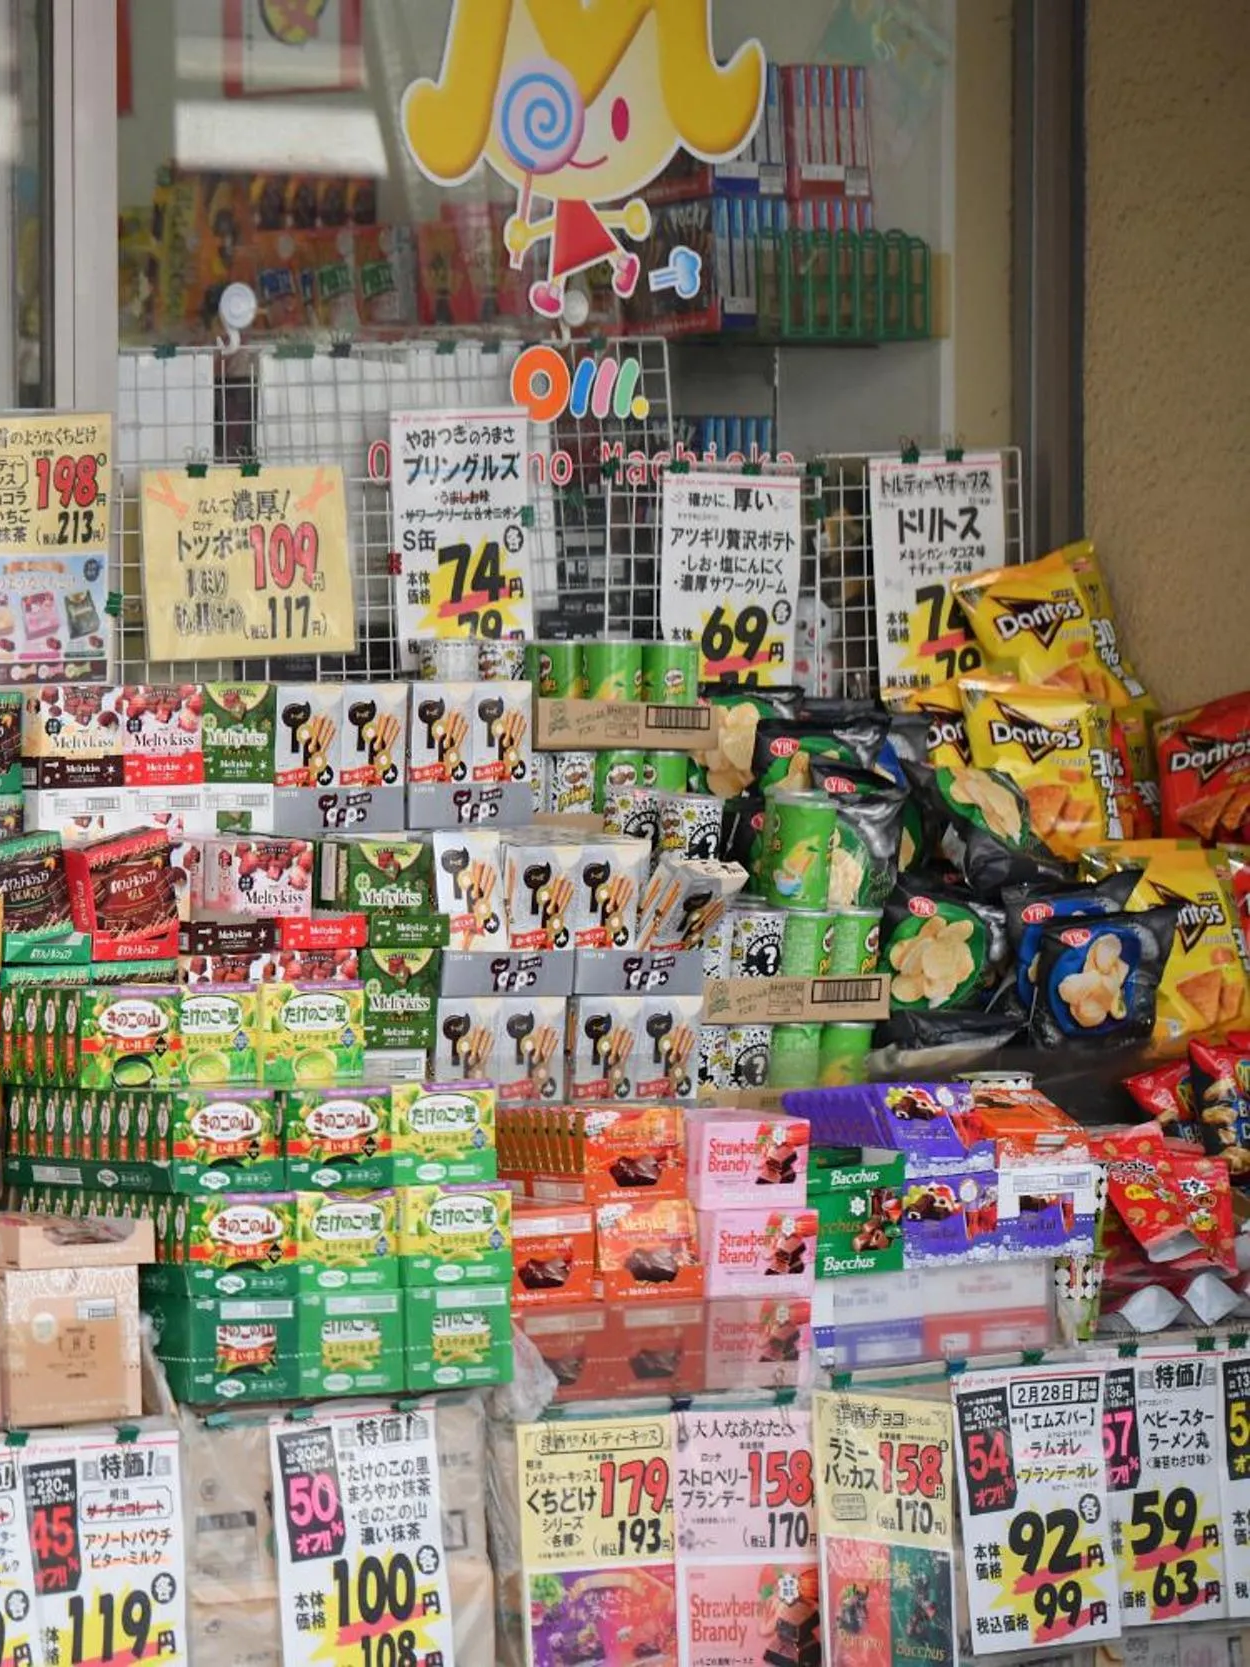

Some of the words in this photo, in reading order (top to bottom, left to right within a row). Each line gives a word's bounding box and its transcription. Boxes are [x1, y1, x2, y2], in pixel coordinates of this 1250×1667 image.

[405, 425, 516, 450] やみつきのうまさ
[402, 452, 521, 486] プリングルズ
[880, 470, 992, 498] トルティーヤチップス
[897, 505, 982, 545] ドリトス
[177, 529, 234, 562] トッポ
[402, 528, 438, 553] S缶
[670, 526, 796, 553] アツギリ贅沢ポテト
[406, 570, 431, 587] 本体
[407, 588, 432, 605] 価格
[886, 611, 910, 625] 本体
[996, 600, 1083, 640] Doritos
[134, 733, 195, 751] Meltykiss
[990, 720, 1082, 749] Doritos
[244, 889, 304, 909] Meltykiss
[104, 1010, 166, 1031] きのこの山
[198, 1111, 256, 1132] きのこの山
[309, 1110, 372, 1130] きのこの山
[708, 1155, 750, 1175] Brandy
[829, 1168, 880, 1187] Bacchus
[217, 1215, 279, 1236] きのこの山
[718, 1247, 759, 1267] Brandy
[823, 1254, 875, 1274] Bacchus
[1154, 1361, 1205, 1390] 特価!
[1017, 1383, 1074, 1404] 2月28日
[692, 1418, 797, 1439] 大人なあなたへ
[1142, 1409, 1215, 1429] ベビースター
[355, 1415, 413, 1447] 特価!
[829, 1436, 870, 1463] ラミー
[968, 1430, 1009, 1481] 54
[99, 1450, 155, 1480] 特価!
[678, 1467, 749, 1488] ストロベリー
[824, 1463, 880, 1491] バッカス
[289, 1471, 338, 1527] 50
[347, 1477, 431, 1506] まろやか抹茶
[526, 1485, 597, 1515] くちどけ
[680, 1489, 747, 1509] ブランデー
[30, 1504, 76, 1560] 45
[360, 1522, 422, 1546] 濃い抹茶
[542, 1516, 585, 1533] シリーズ
[83, 1527, 174, 1550] アソートパウチ
[973, 1543, 1001, 1561] 本体
[975, 1561, 1002, 1580] 価格
[294, 1590, 325, 1610] 本体
[295, 1612, 327, 1632] 価格
[975, 1612, 1030, 1634] 税込価格
[689, 1618, 748, 1652] Brandy
